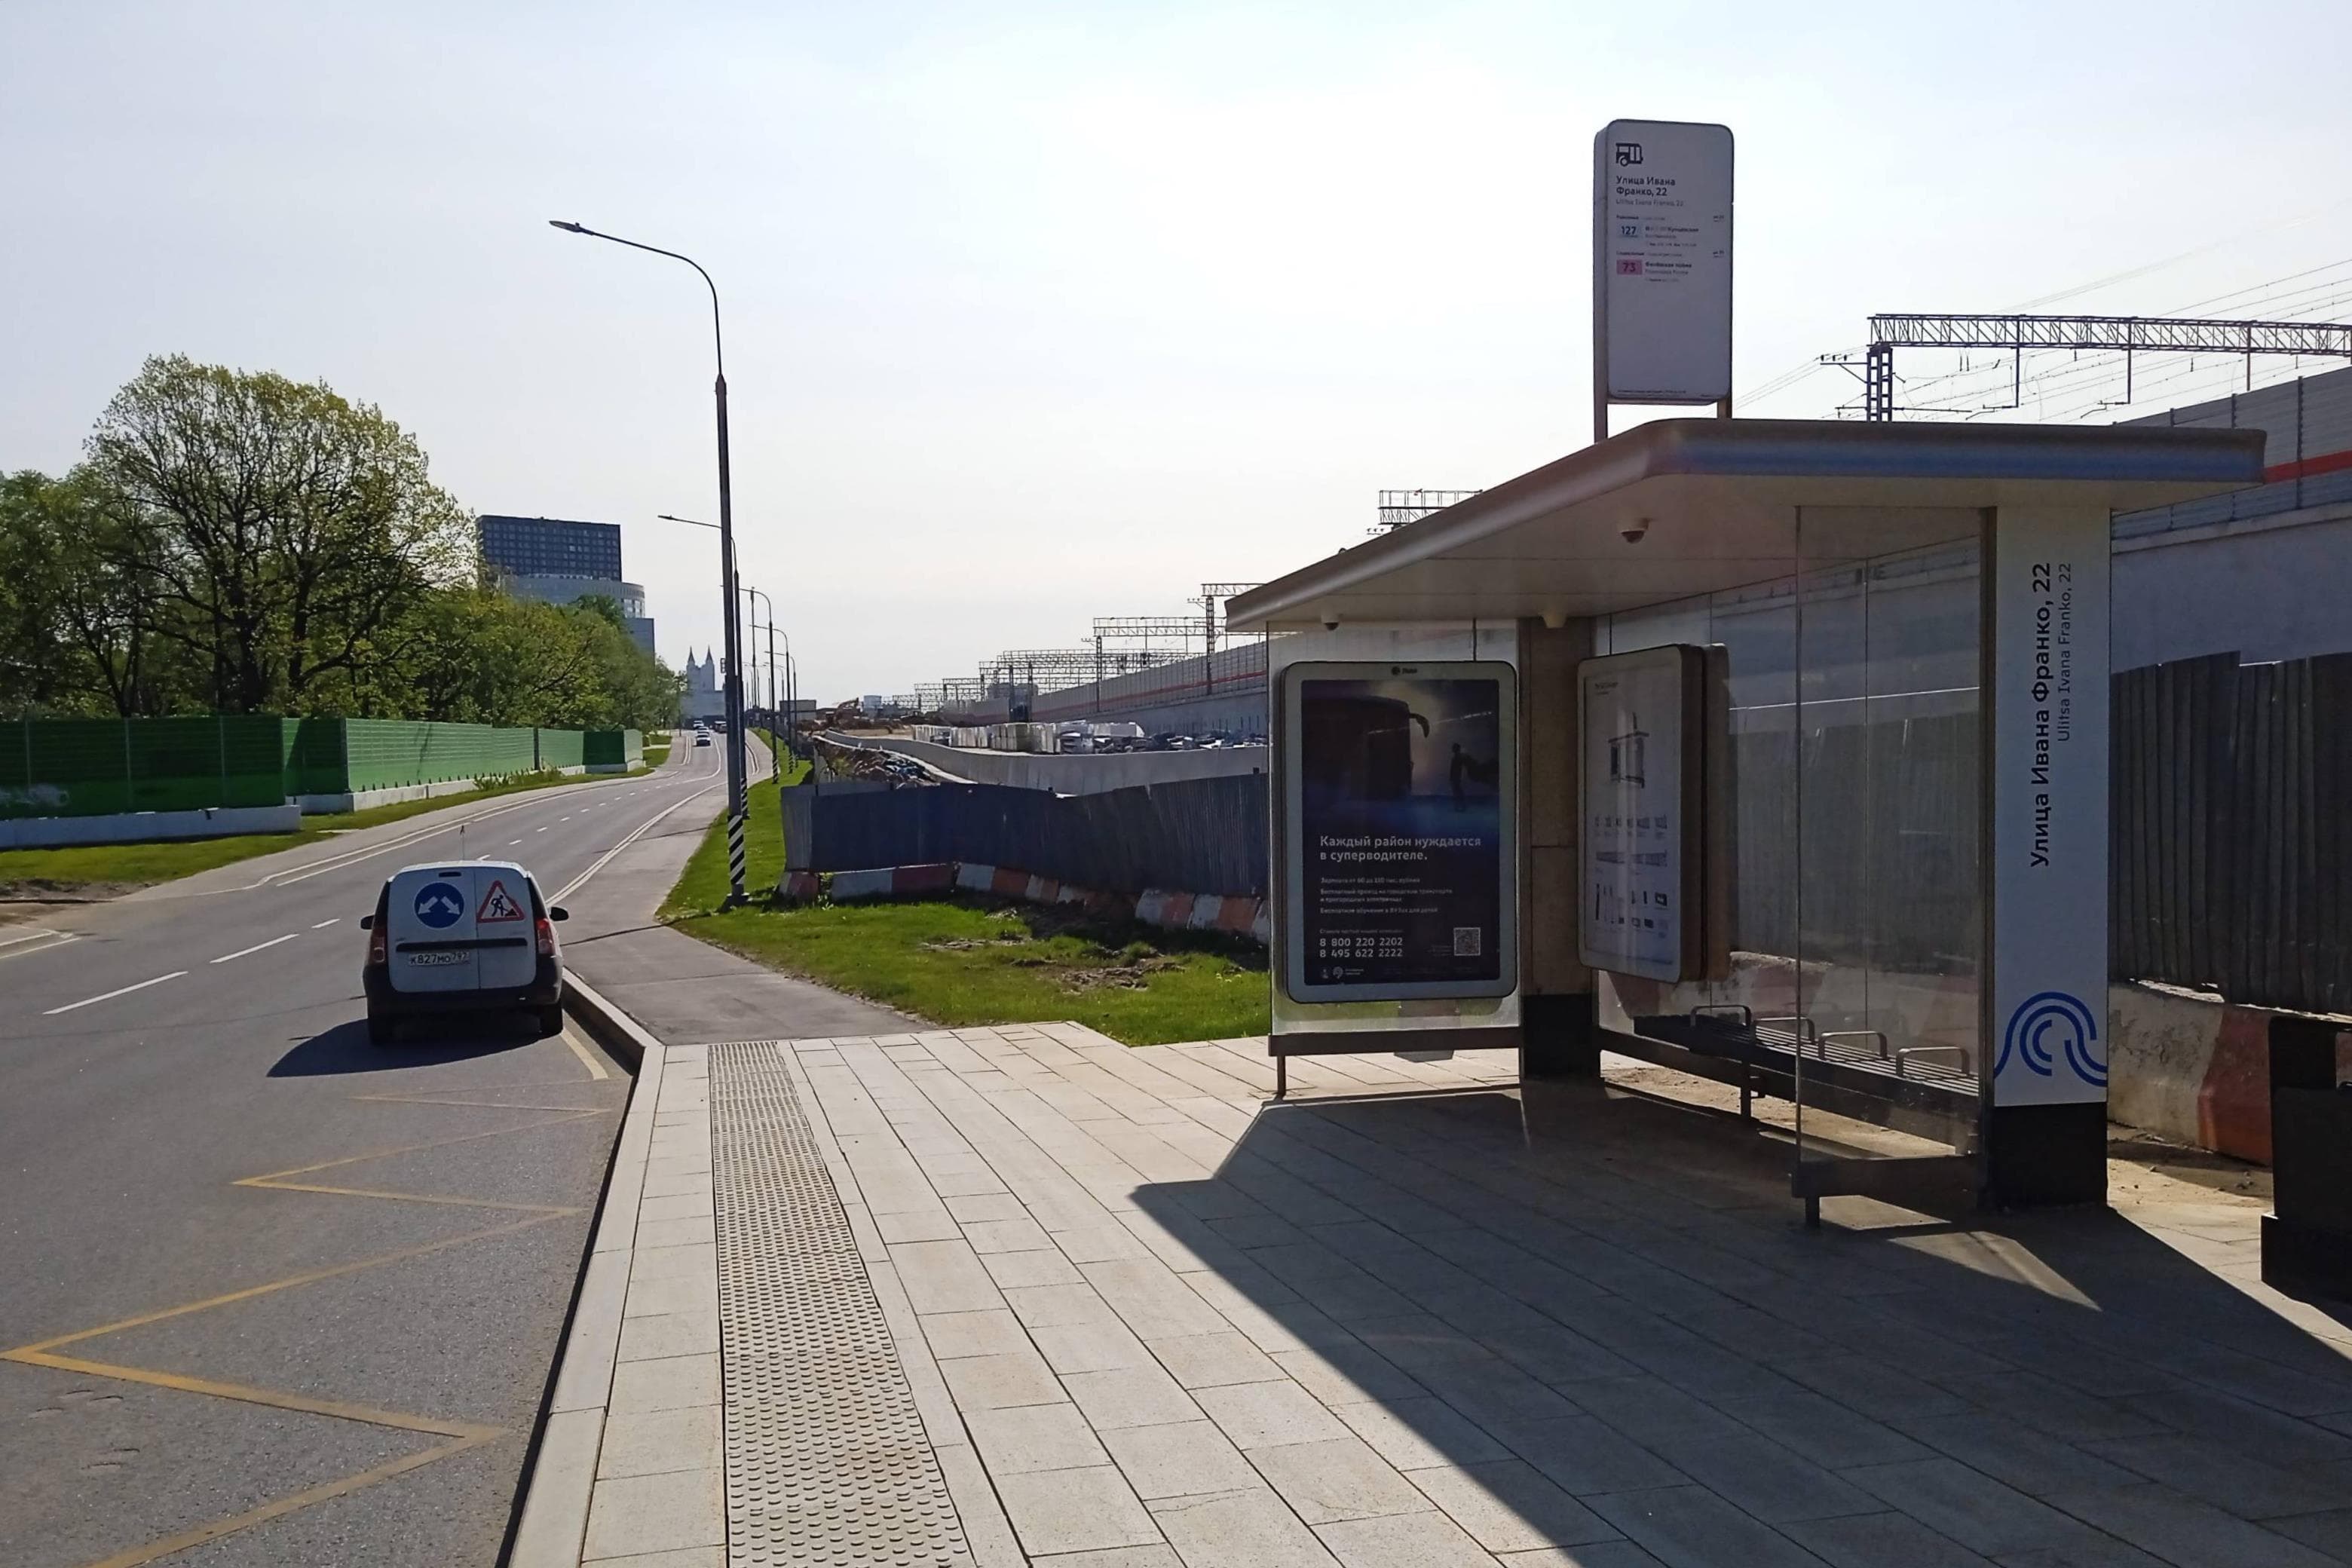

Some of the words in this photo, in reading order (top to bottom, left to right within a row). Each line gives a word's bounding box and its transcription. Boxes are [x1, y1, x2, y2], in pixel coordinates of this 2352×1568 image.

[1615, 175, 1645, 185] Улица
[1646, 176, 1676, 186] Ивана
[1615, 186, 1654, 197] Франко,
[1655, 187, 1668, 196] 22
[1622, 225, 1637, 235] 127
[1622, 262, 1636, 272] 73
[2032, 562, 2050, 593] 22
[2058, 563, 2071, 583] 22
[2057, 587, 2072, 645] Franko,
[2031, 601, 2053, 703] Франко,
[2057, 650, 2071, 694] Ivana
[2057, 698, 2071, 742] Ulitsa
[2030, 709, 2050, 785] Ивана
[2030, 793, 2051, 868] Улица
[1319, 835, 1370, 847] Каждый
[1374, 836, 1412, 849] район
[1415, 838, 1482, 850] нуждается
[1319, 852, 1327, 860] в
[1330, 852, 1429, 862] суперводителе.
[1319, 938, 1327, 947] 8
[1331, 938, 1351, 947] 800
[1355, 937, 1375, 947] 220
[1379, 937, 1403, 946] 2202
[1319, 949, 1327, 958] 8
[1331, 949, 1350, 958] 495
[1355, 948, 1374, 958] 622
[1379, 948, 1404, 957] 2222
